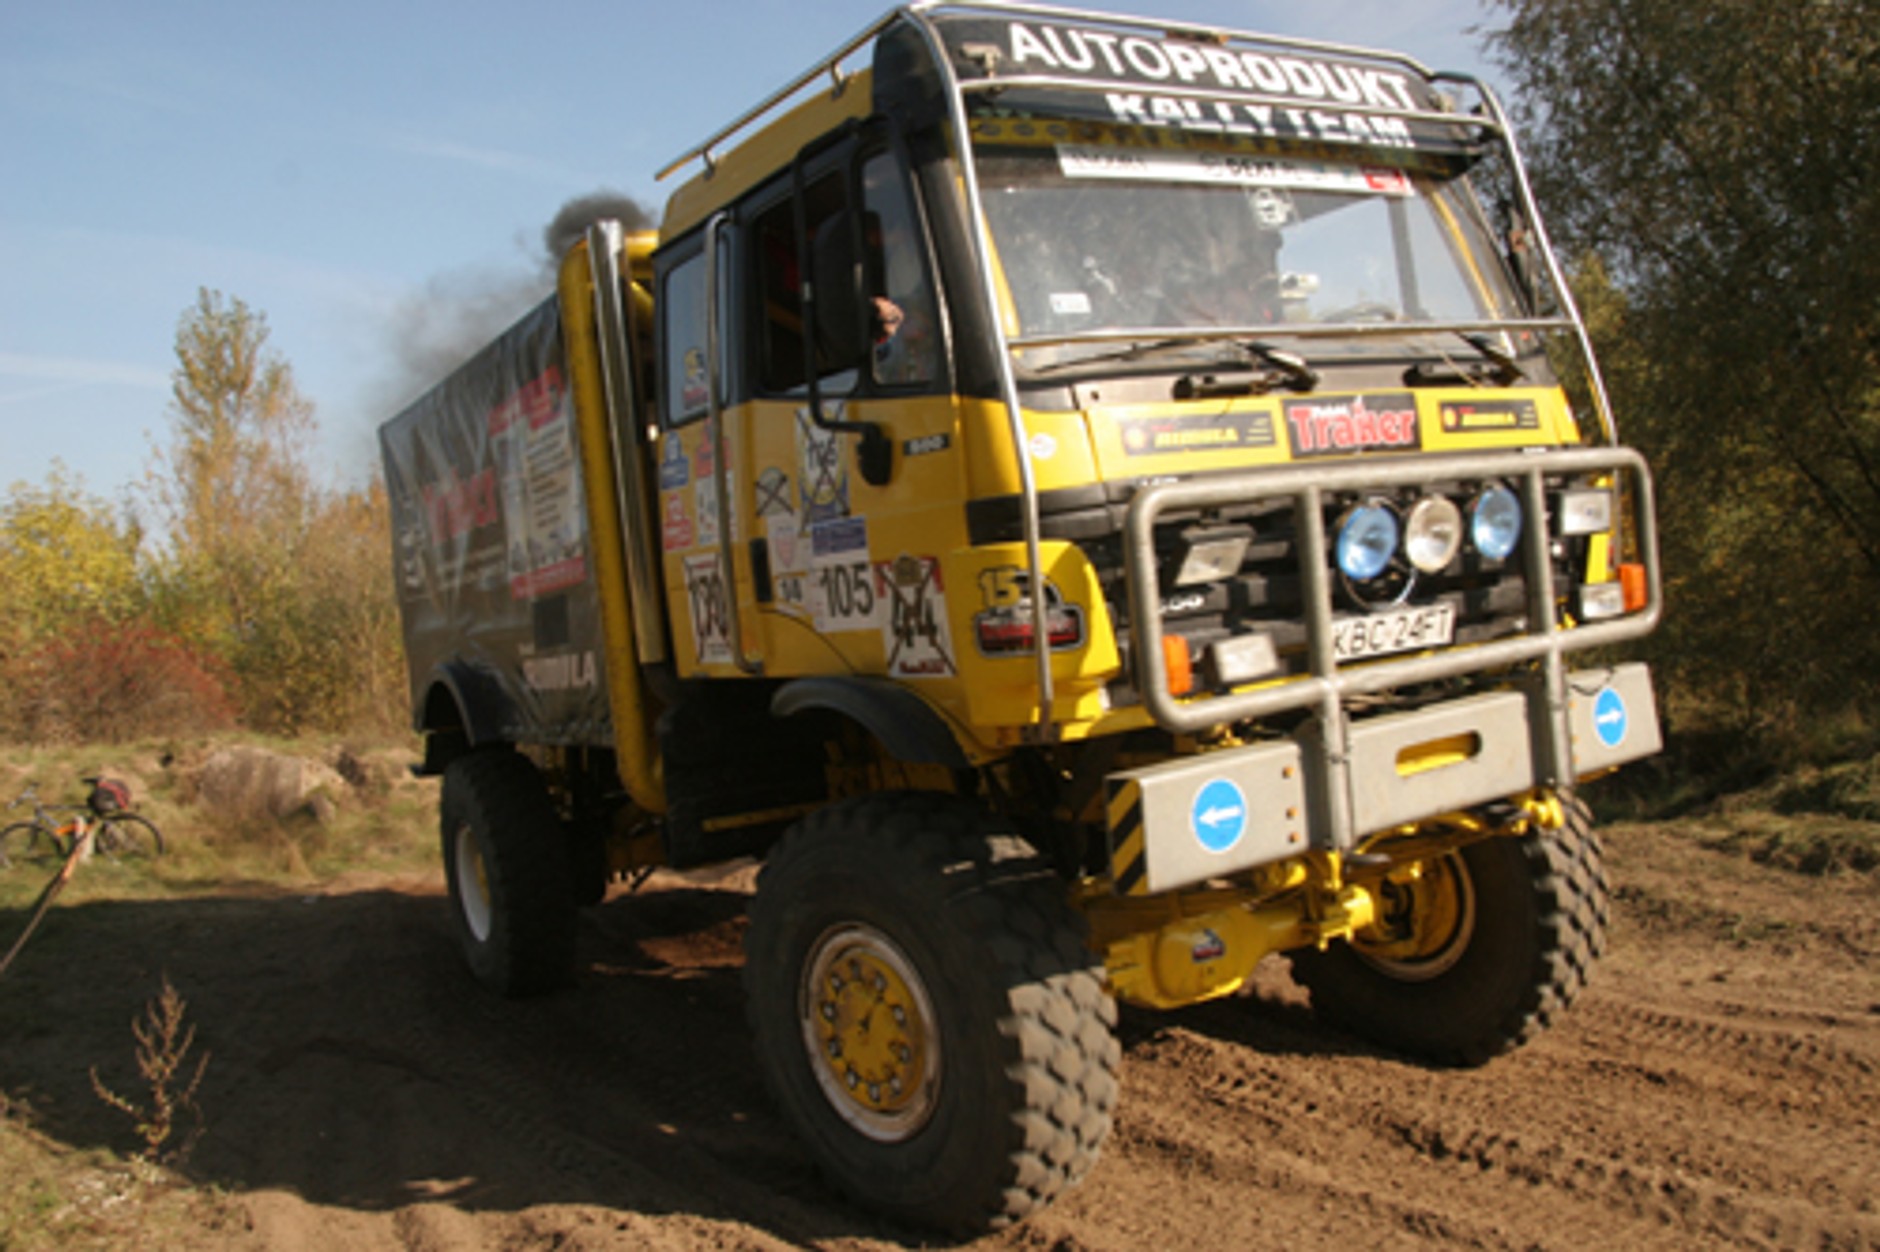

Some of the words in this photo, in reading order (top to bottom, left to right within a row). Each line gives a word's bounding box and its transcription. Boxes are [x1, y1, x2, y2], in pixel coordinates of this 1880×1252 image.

[1009, 21, 1417, 111] AUTOPRODUKT
[819, 561, 875, 619] 105
[1334, 618, 1386, 656] KBC
